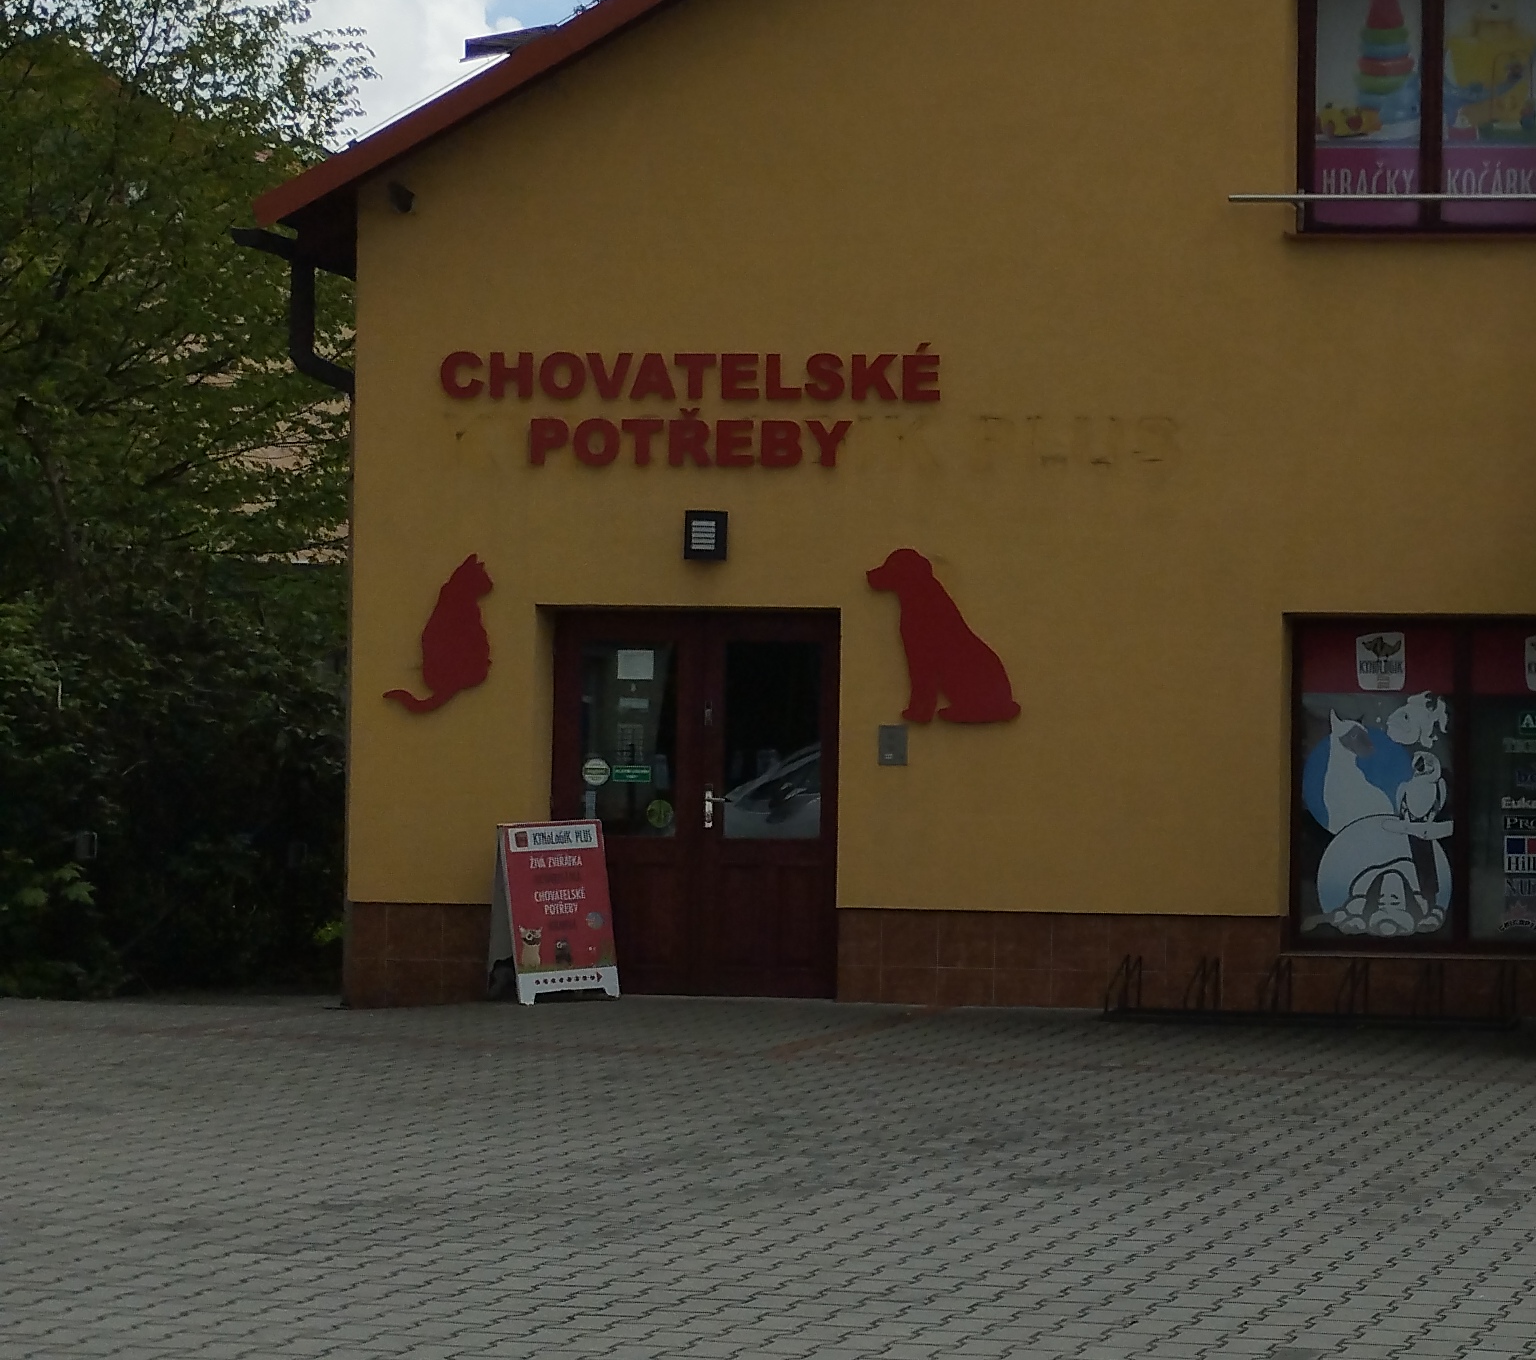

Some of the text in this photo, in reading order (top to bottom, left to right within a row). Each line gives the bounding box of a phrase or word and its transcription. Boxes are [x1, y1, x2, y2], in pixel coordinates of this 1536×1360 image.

[1321, 161, 1416, 195] HRAČKY
[440, 342, 941, 402] CHOVATELSKÉ
[529, 407, 853, 469] POTŘEBY
[575, 828, 592, 844] PLUS
